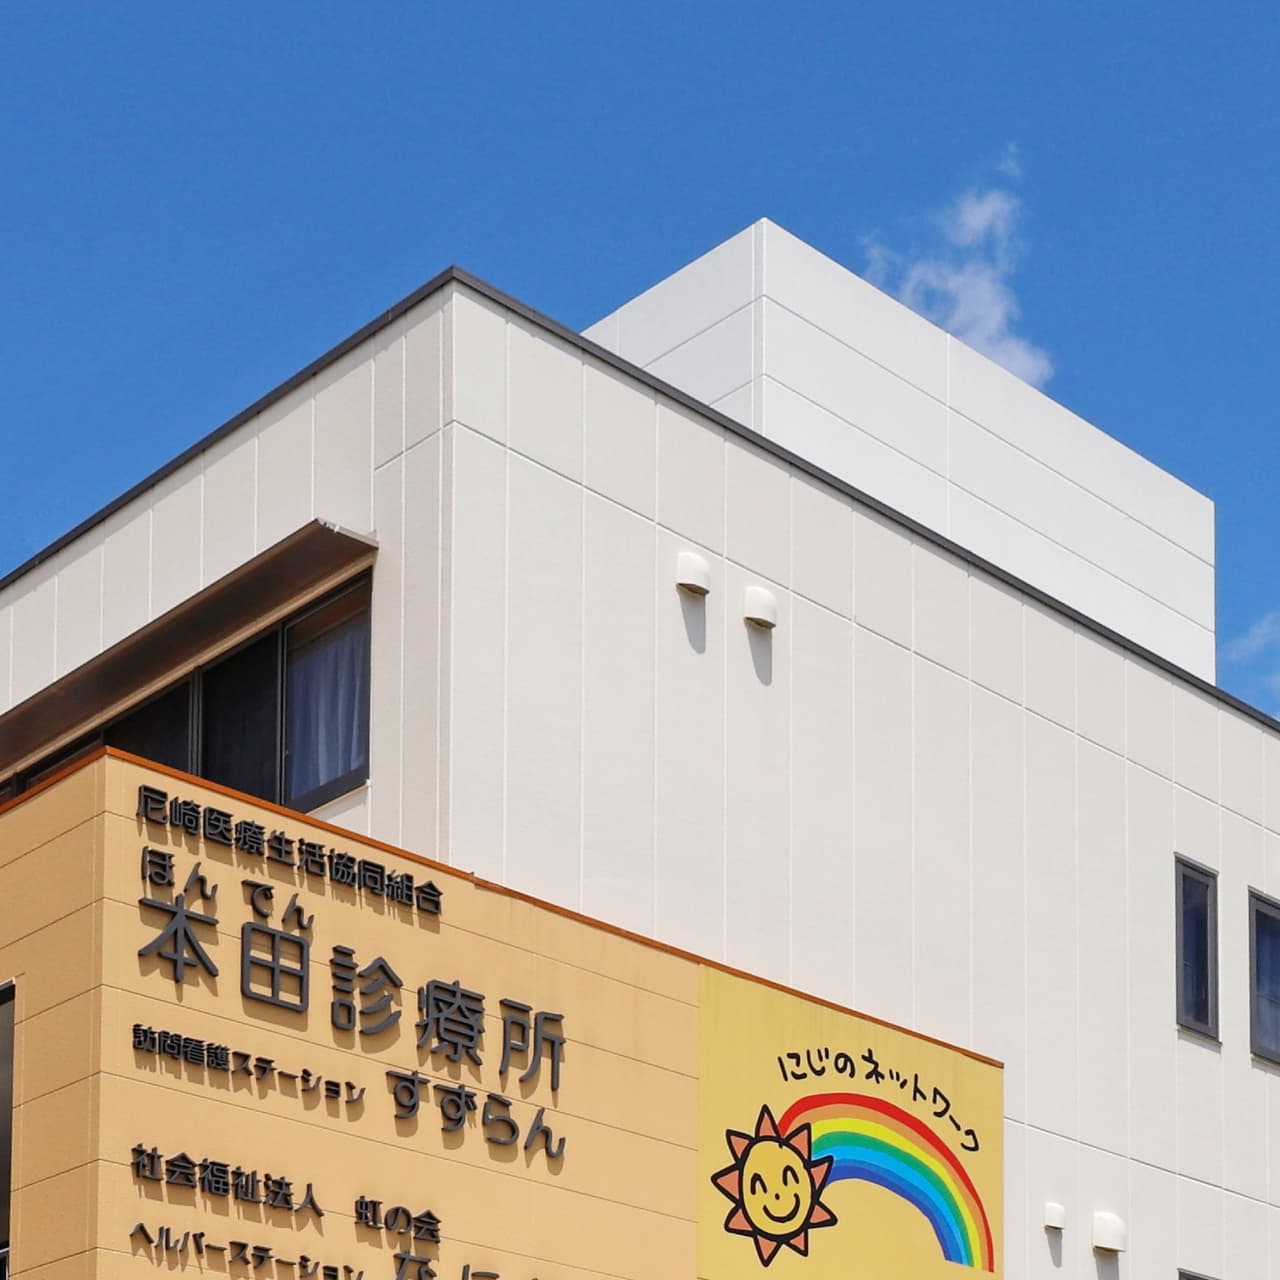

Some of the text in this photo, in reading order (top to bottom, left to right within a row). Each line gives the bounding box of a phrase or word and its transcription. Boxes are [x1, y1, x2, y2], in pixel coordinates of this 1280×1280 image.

[136, 784, 442, 915] 尼崎医療生活協同組合
[138, 893, 565, 1092] 本田診療所
[133, 1023, 566, 1159] 訪問看護ステーション すずらん
[778, 1047, 980, 1152] にじのネットワーク
[131, 1143, 441, 1244] 社会福祉法人 虹の会
